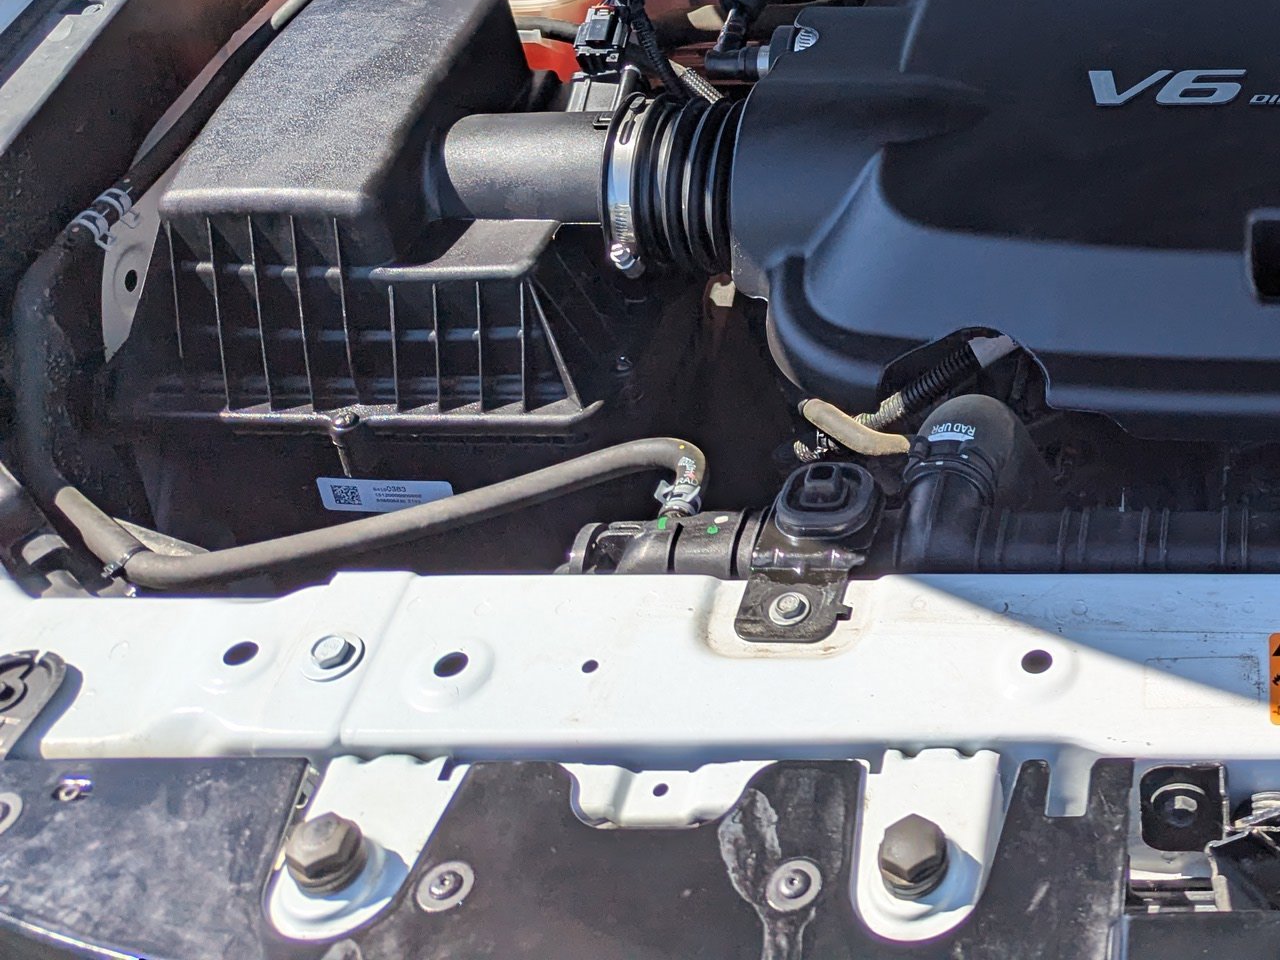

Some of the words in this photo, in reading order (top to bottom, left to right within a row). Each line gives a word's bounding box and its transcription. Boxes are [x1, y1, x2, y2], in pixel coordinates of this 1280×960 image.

[1088, 69, 1247, 106] V6
[931, 422, 951, 434] UPR
[953, 423, 976, 436] RAD
